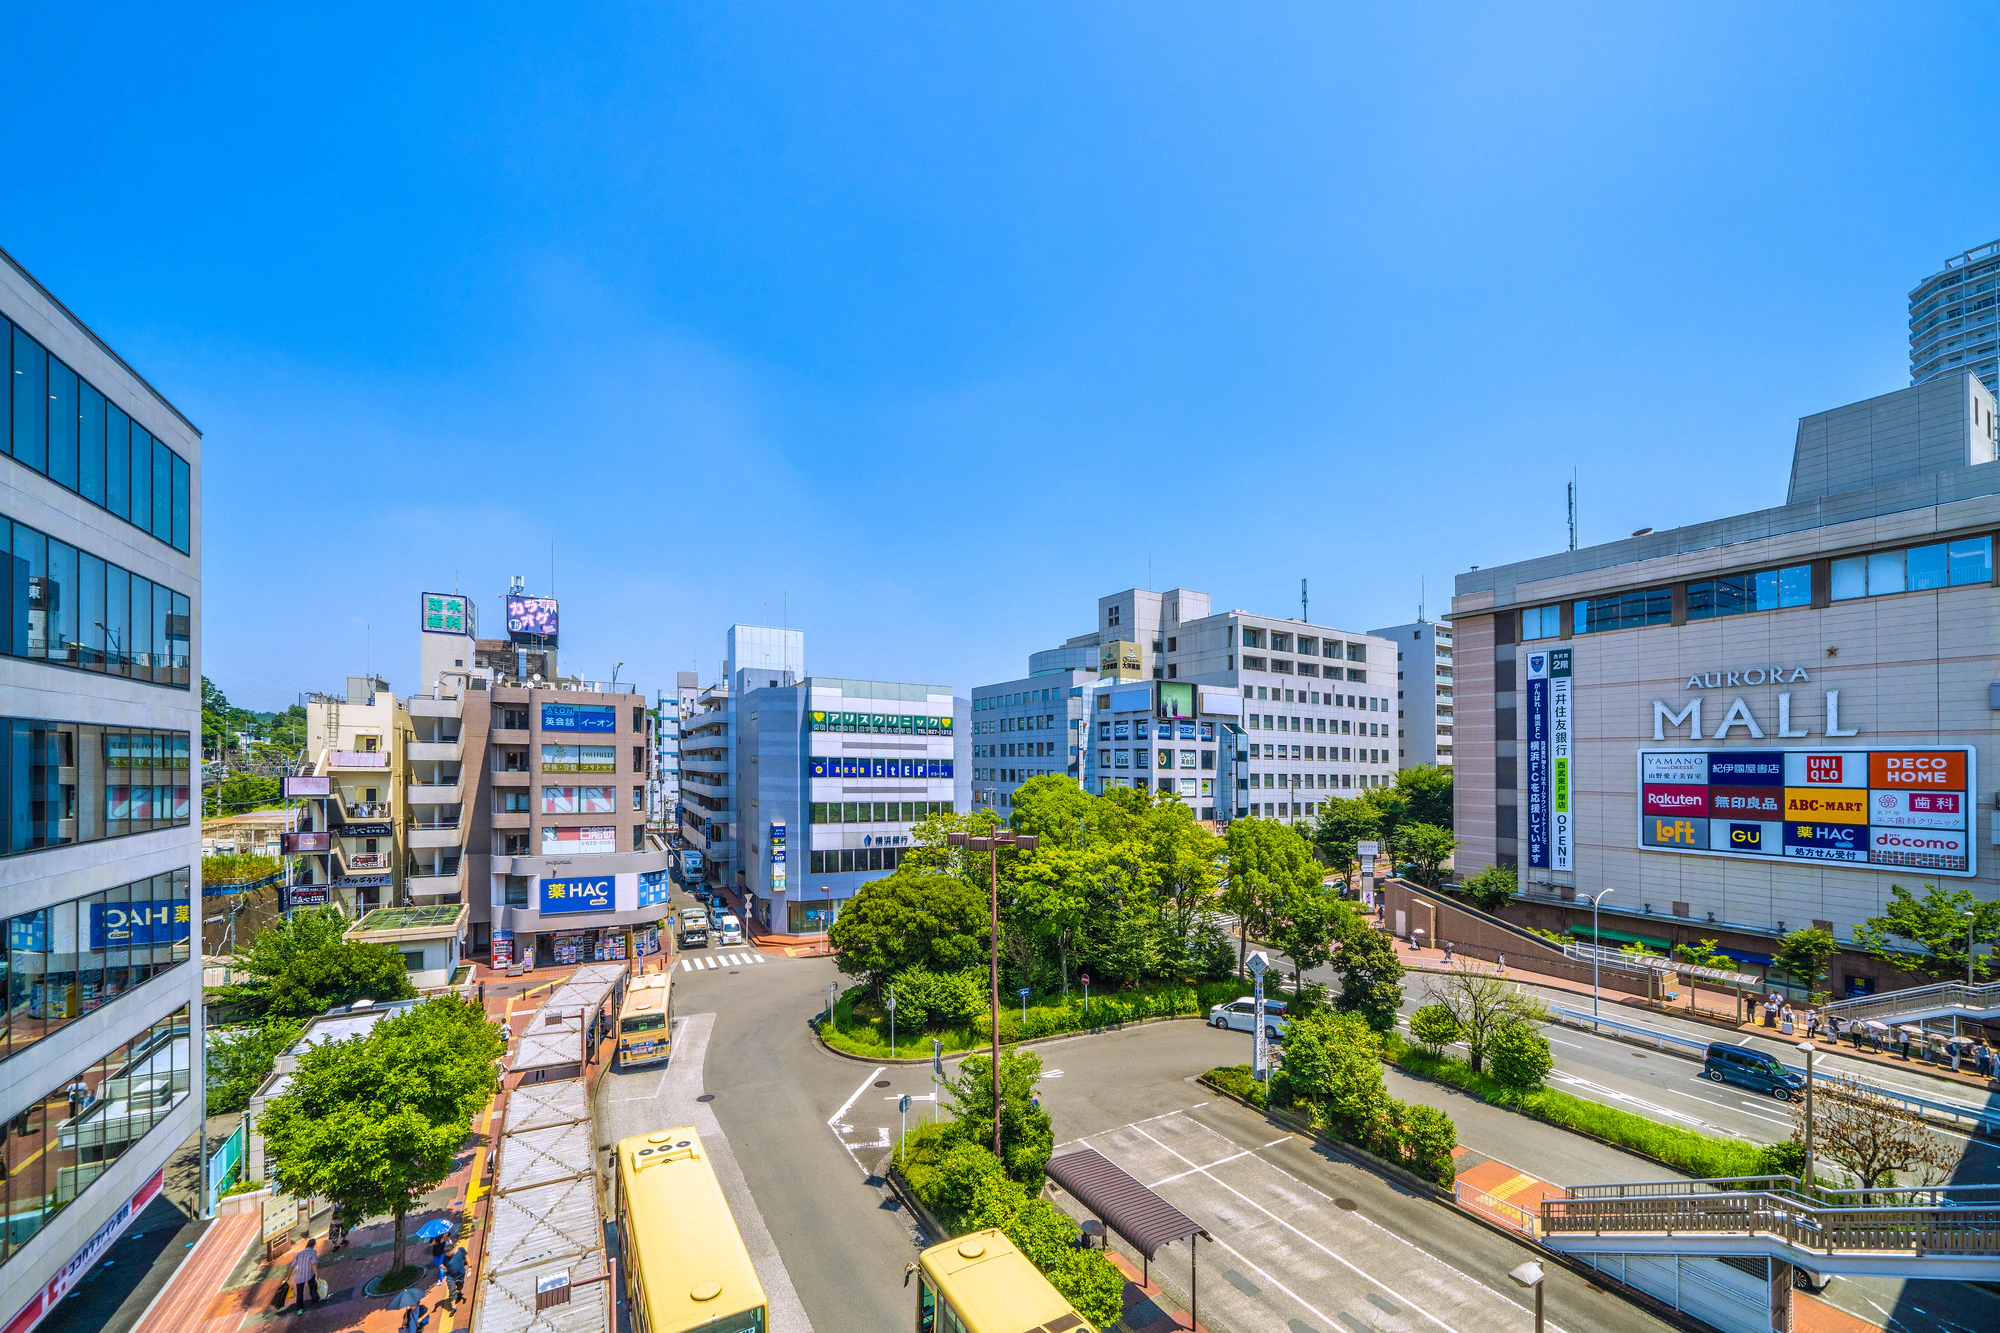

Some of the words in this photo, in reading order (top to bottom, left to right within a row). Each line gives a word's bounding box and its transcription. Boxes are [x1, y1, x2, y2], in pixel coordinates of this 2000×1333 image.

[427, 614, 462, 630] 歯科
[1552, 660, 1569, 671] 2階
[1685, 665, 1811, 690] AURORA
[829, 713, 938, 727] アリスクリニック
[1555, 680, 1568, 756] 三井住友銀行
[1651, 689, 1862, 741] MALL
[545, 717, 575, 727] 英会話
[581, 718, 615, 728] イーオン
[1712, 763, 1780, 774] 紀伊國屋書店
[1810, 759, 1836, 769] UNI
[1887, 758, 1947, 769] DECO
[1648, 772, 1702, 780] 山野愛子美容室
[1810, 770, 1839, 781] QLO
[1887, 771, 1947, 783] HOME
[1557, 762, 1566, 809] 西武東戸塚店
[1530, 741, 1541, 863] 横浜FCを応援しています
[1648, 793, 1702, 806] Rakuten
[1714, 795, 1778, 811] 無印良品
[1788, 799, 1863, 812] ABC-MART
[1914, 796, 1954, 811] 歯科
[1876, 816, 1960, 827] エス歯科クリニック
[1731, 830, 1760, 843] GU
[1797, 826, 1813, 839] 薬
[1816, 827, 1854, 841] HAC
[875, 836, 908, 846] 横浜銀行
[1557, 815, 1567, 867] OPEN!!
[1876, 833, 1959, 850] docomo
[1795, 847, 1856, 860] 処方せん受付
[548, 883, 566, 899] 薬
[569, 881, 609, 898] HAC
[68, 1204, 129, 1277] ココカラファイン薬局
